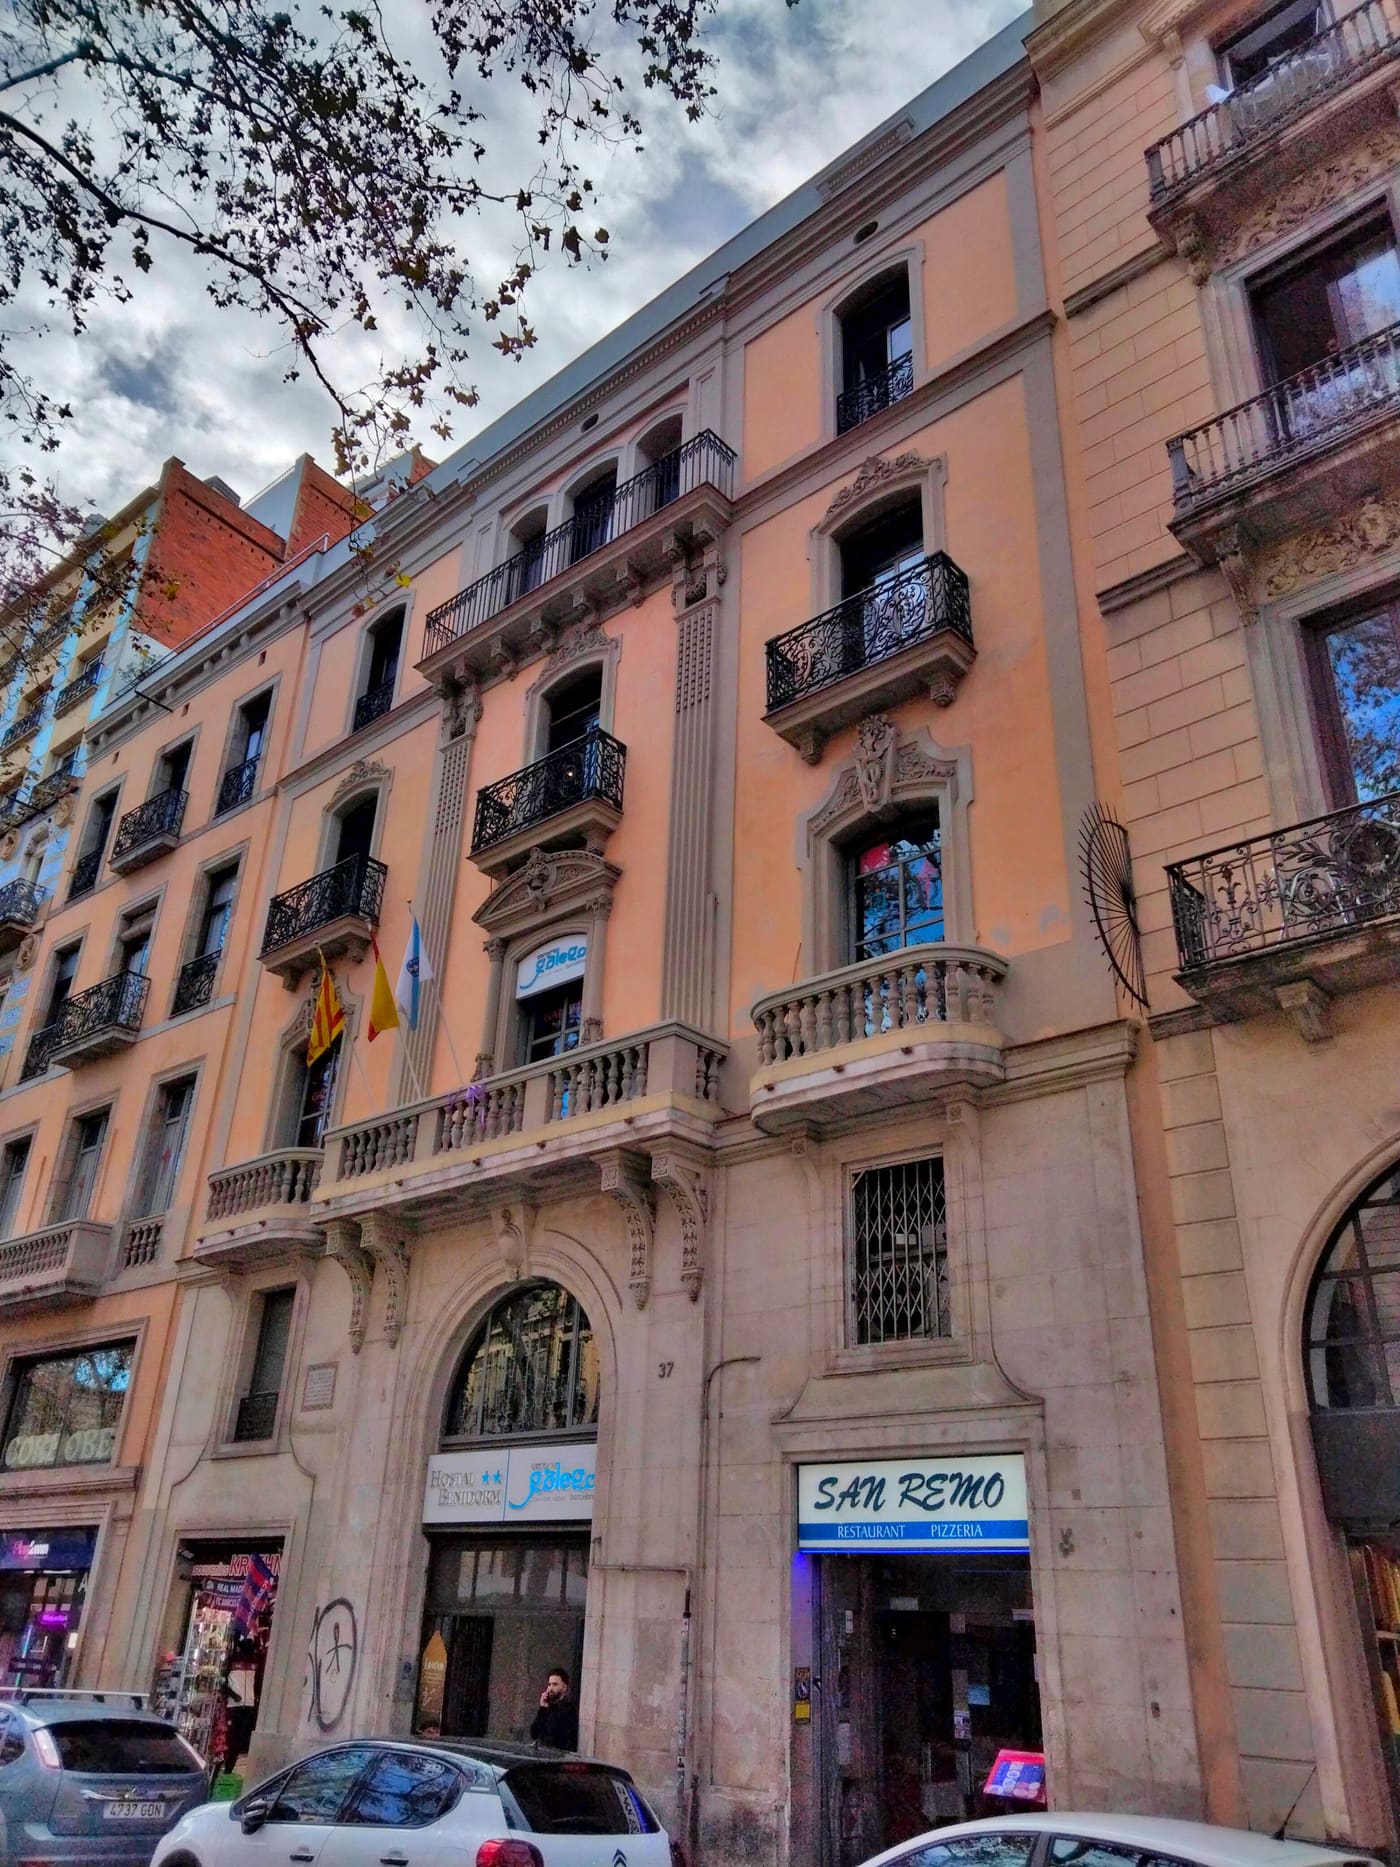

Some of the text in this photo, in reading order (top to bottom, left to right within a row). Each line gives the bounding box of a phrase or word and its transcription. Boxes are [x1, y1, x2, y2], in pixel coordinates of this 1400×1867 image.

[658, 1361, 674, 1378] 37
[430, 1470, 474, 1488] HOSTAL
[814, 1472, 1005, 1512] SAN REMO
[837, 1524, 983, 1539] RESTAURANT PIZZERIA
[110, 1804, 138, 1816] 4737
